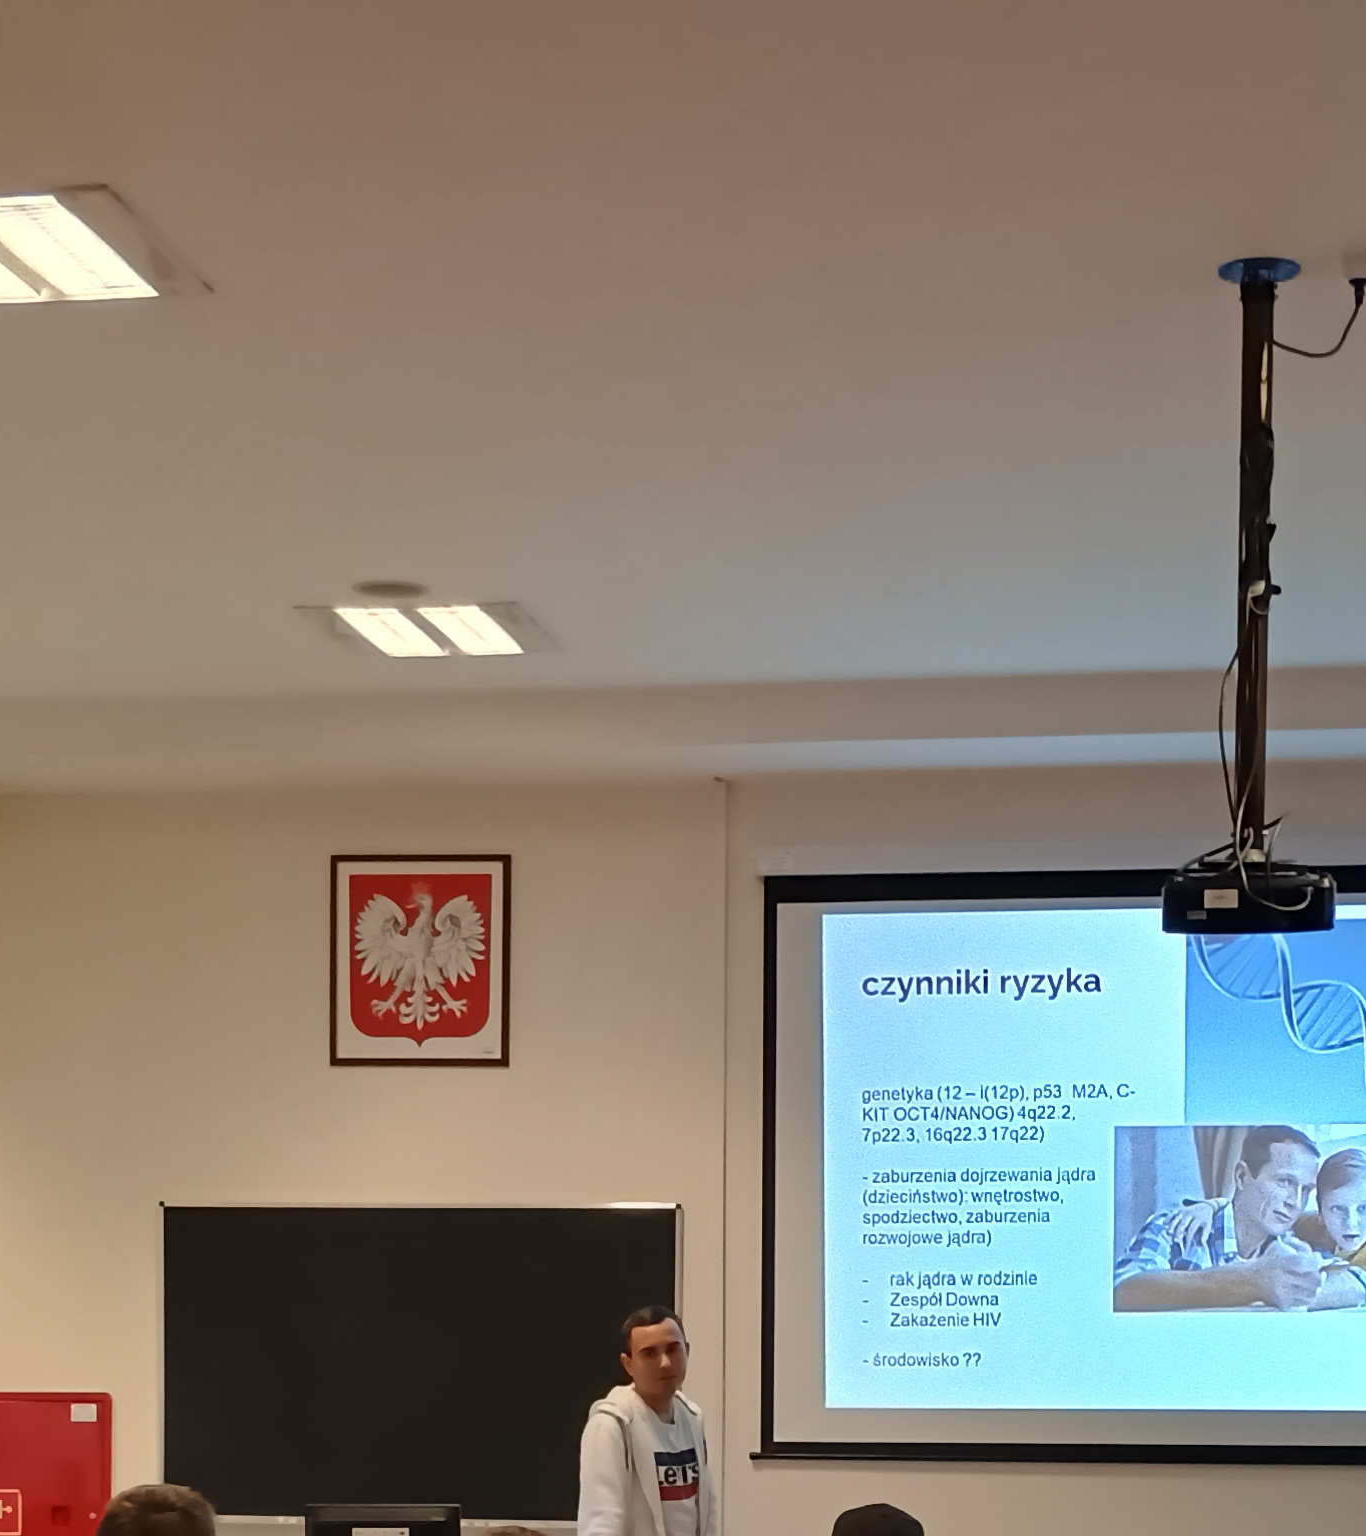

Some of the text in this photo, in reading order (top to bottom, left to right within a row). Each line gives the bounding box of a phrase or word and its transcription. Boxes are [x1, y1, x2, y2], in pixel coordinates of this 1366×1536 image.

[861, 966, 1102, 1004] czynniki ryzyka
[861, 1085, 934, 1105] genetyka
[937, 1085, 962, 1104] (12
[1033, 1083, 1062, 1103] p53
[1072, 1083, 1113, 1100] M2A,
[1116, 1083, 1136, 1098] C-
[862, 1104, 1076, 1123] KIT OCT4/NANOG) 4q22.2,
[861, 1125, 1045, 1145] 7p22.3, 16q22.3 17q22)
[871, 1168, 957, 1184] zaburzenia
[960, 1166, 1053, 1186] dojrzewania
[1055, 1166, 1096, 1185] jądra
[970, 1188, 1064, 1206] wnętrostwo,
[862, 1207, 1051, 1228] spodziectwo, zaburzenia
[862, 1229, 992, 1248] rozwojowe jądra)
[890, 1270, 915, 1287] rak
[916, 1270, 957, 1290] jądra
[960, 1273, 974, 1286] w
[977, 1269, 1038, 1286] rodzinie
[889, 1291, 943, 1310] Zespół
[945, 1291, 999, 1307] Downa
[889, 1311, 970, 1328] Zakażenie
[973, 1311, 1002, 1327] HIV
[872, 1351, 960, 1368] środowisko
[962, 1351, 982, 1368] ??
